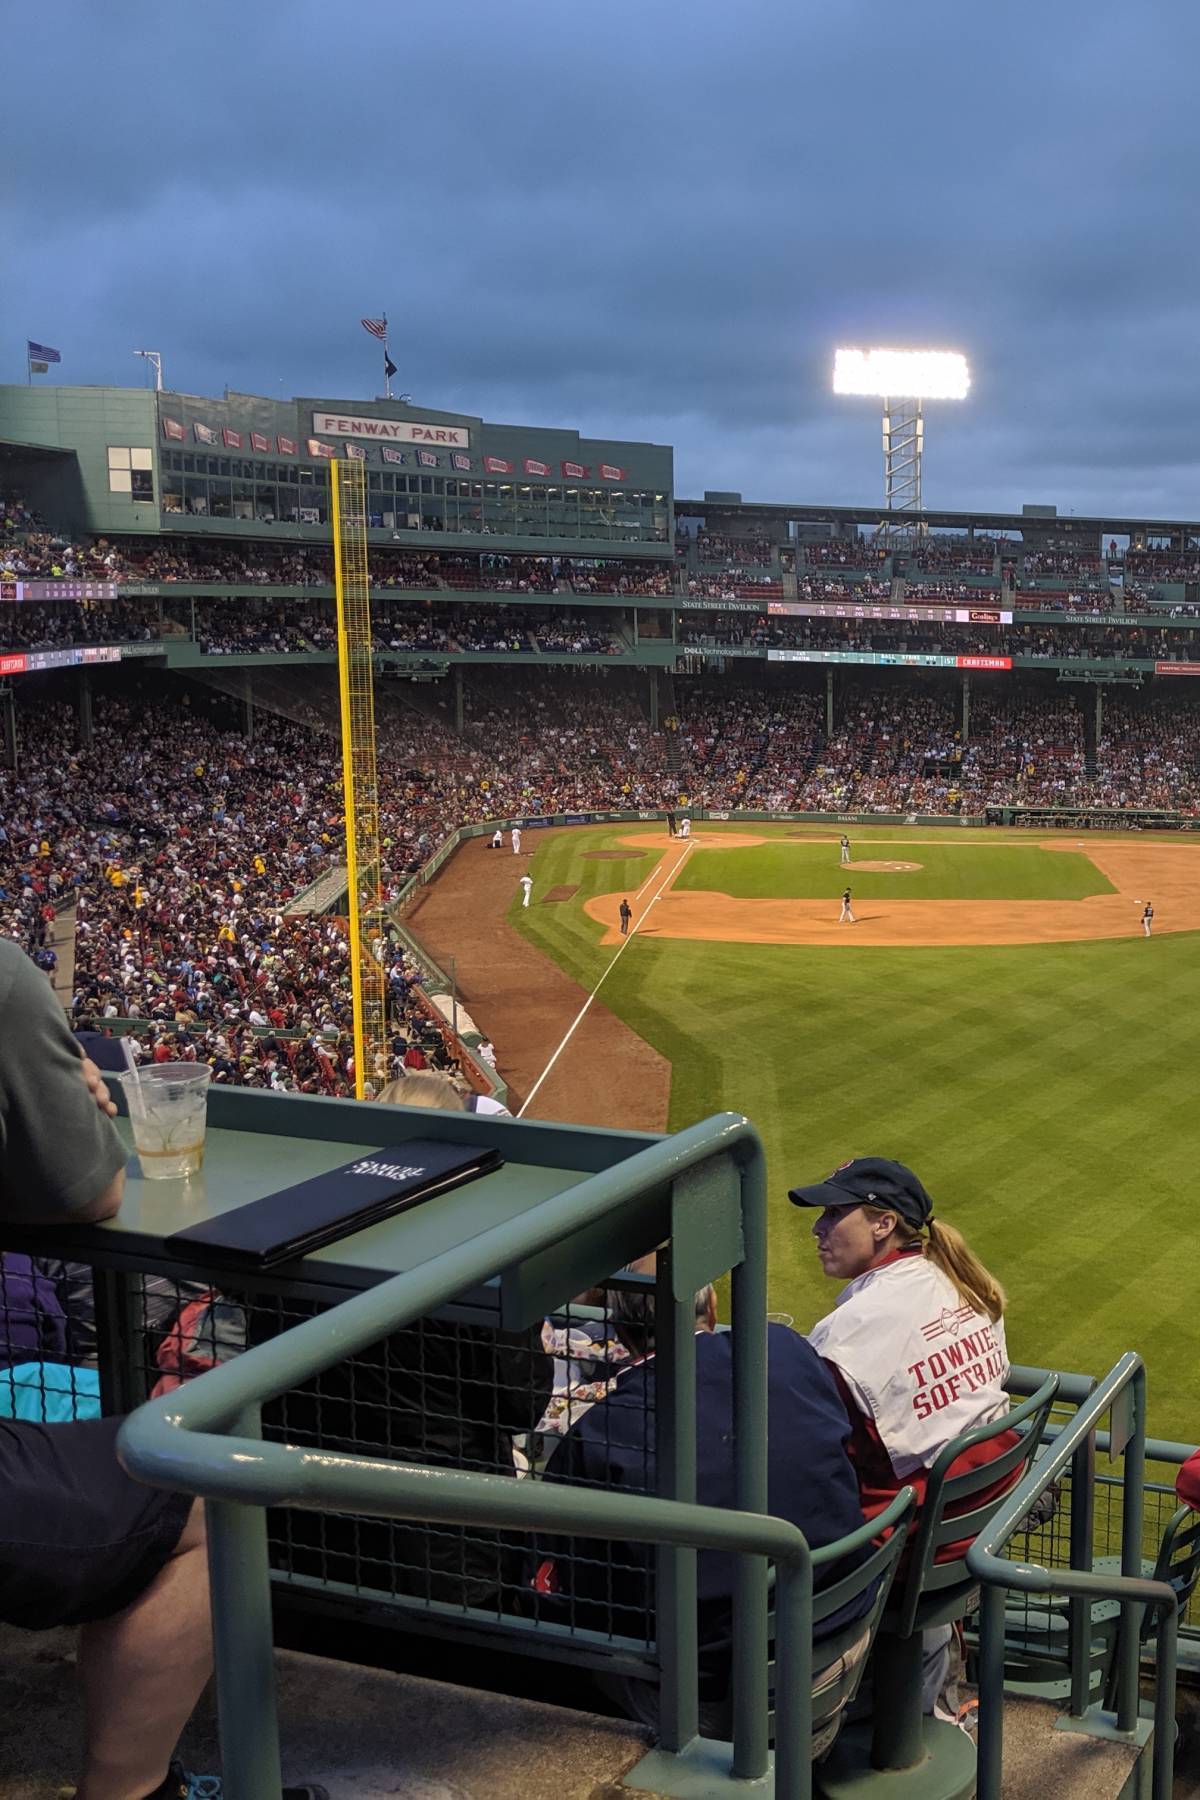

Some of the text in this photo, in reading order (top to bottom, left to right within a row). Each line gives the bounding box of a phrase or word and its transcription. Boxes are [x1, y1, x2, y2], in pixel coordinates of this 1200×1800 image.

[324, 418, 460, 443] FENWAY PARK
[682, 600, 760, 611] STATE STREET PAVILION
[1065, 615, 1138, 625] STATE STREET PAVILION
